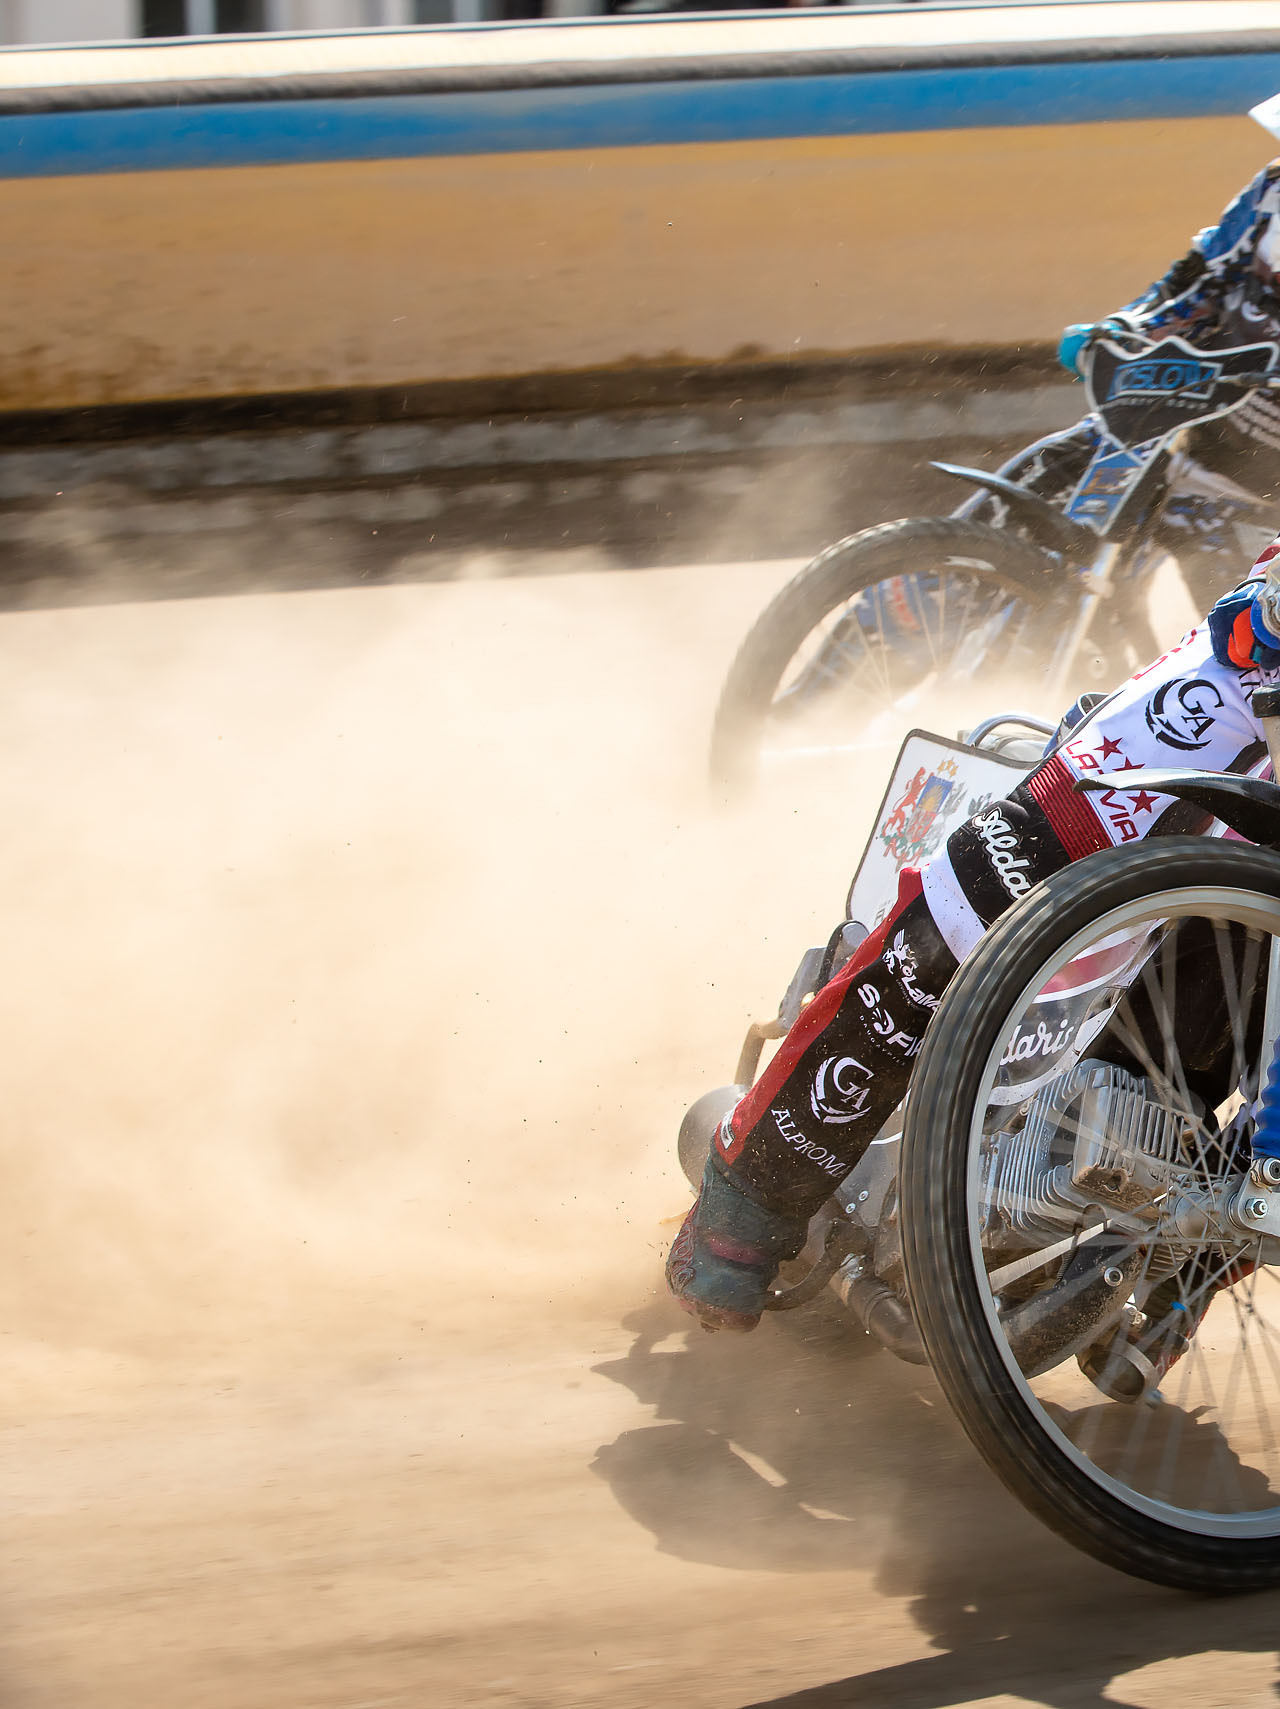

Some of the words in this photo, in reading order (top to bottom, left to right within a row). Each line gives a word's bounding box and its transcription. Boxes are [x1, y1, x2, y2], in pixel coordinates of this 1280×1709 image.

[1177, 678, 1225, 742] GA
[1065, 740, 1140, 843] LAVIA
[1000, 1019, 1075, 1066] daris
